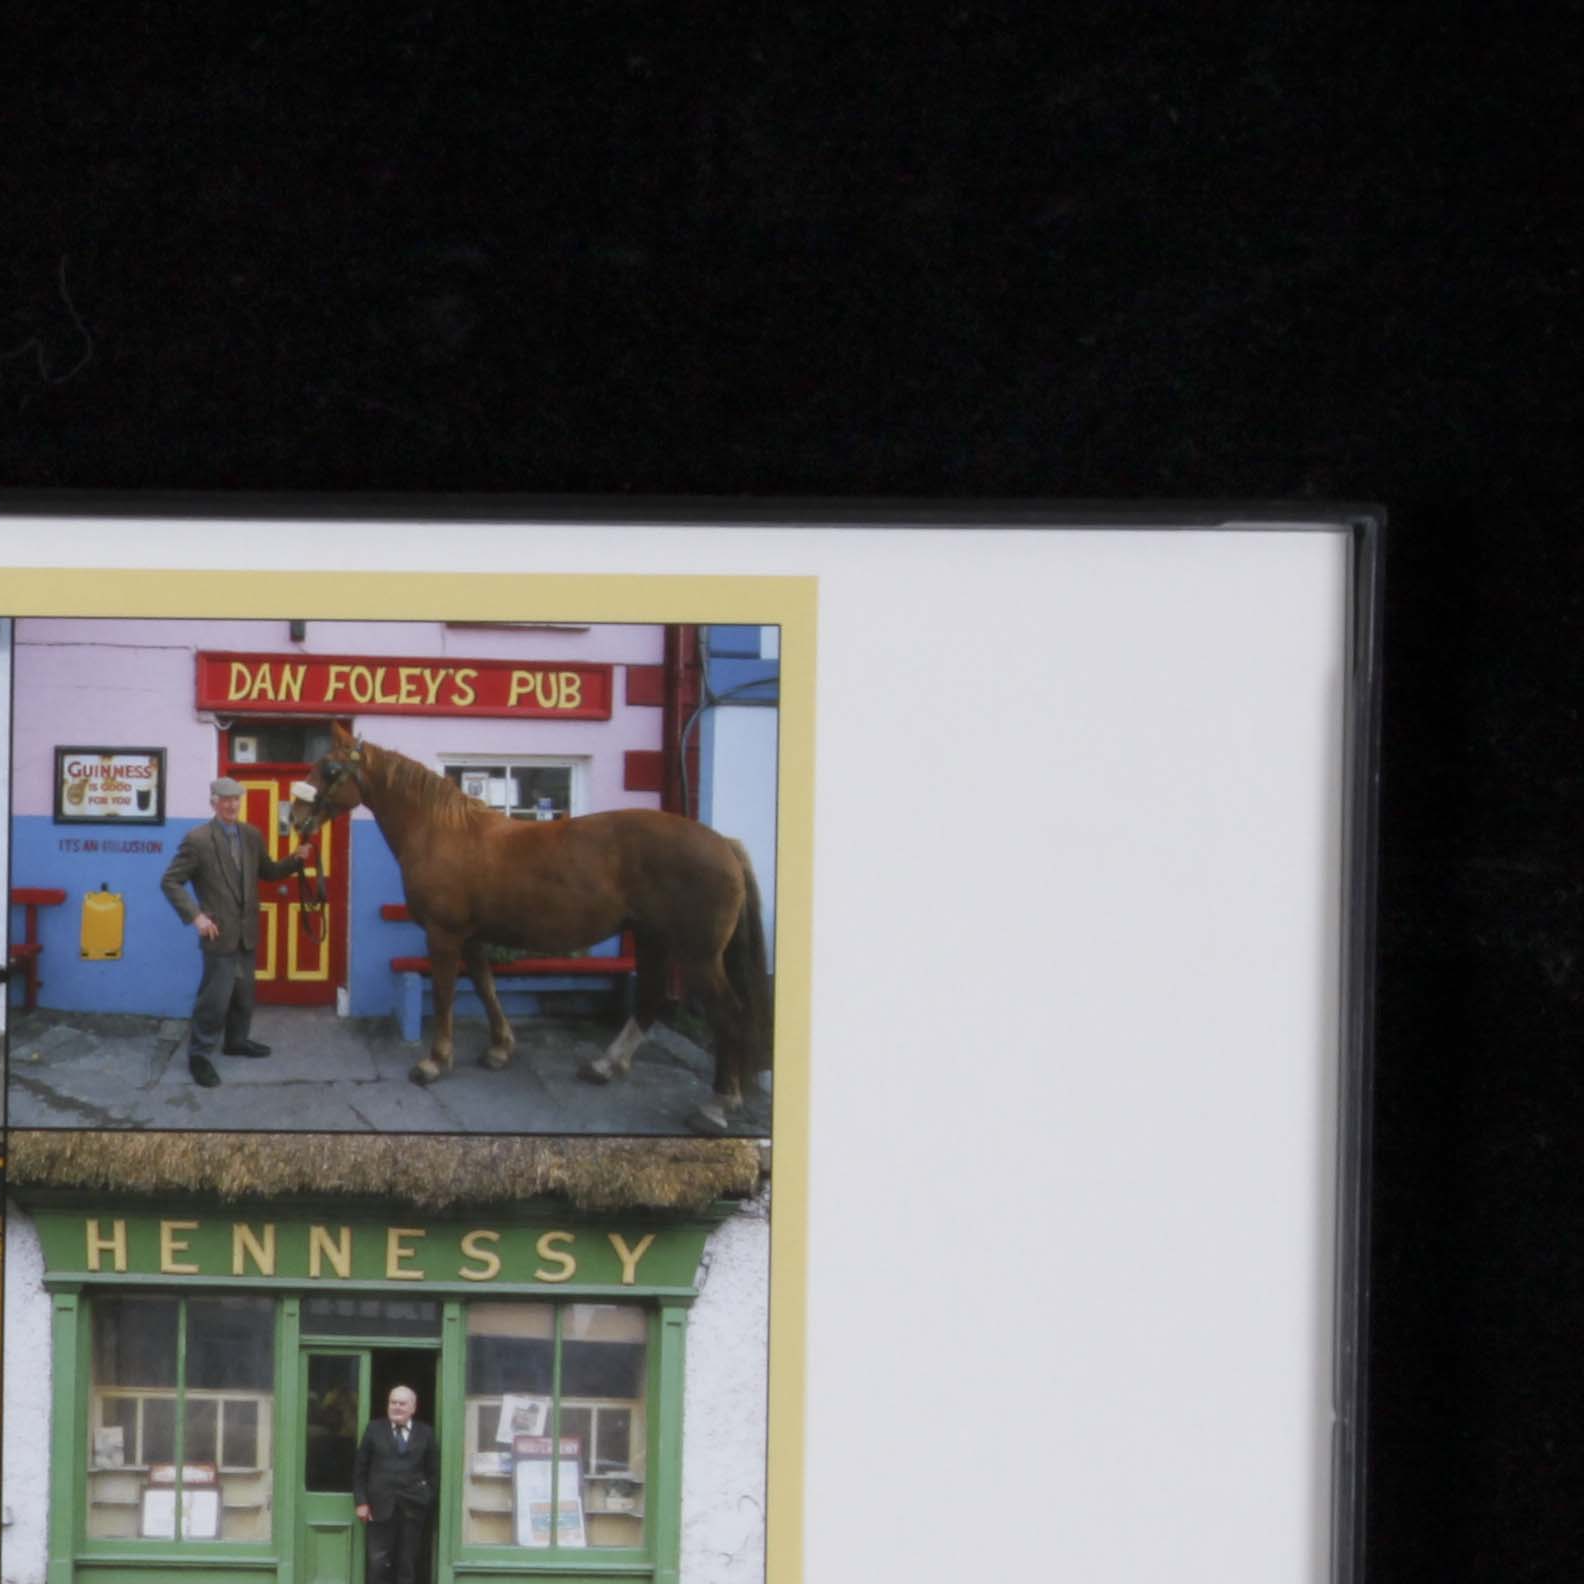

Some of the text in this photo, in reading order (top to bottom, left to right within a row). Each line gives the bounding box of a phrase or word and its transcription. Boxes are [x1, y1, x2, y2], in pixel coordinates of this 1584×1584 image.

[228, 661, 582, 709] DAN FOLEY'S PUB
[85, 1218, 656, 1285] HENNESSY
